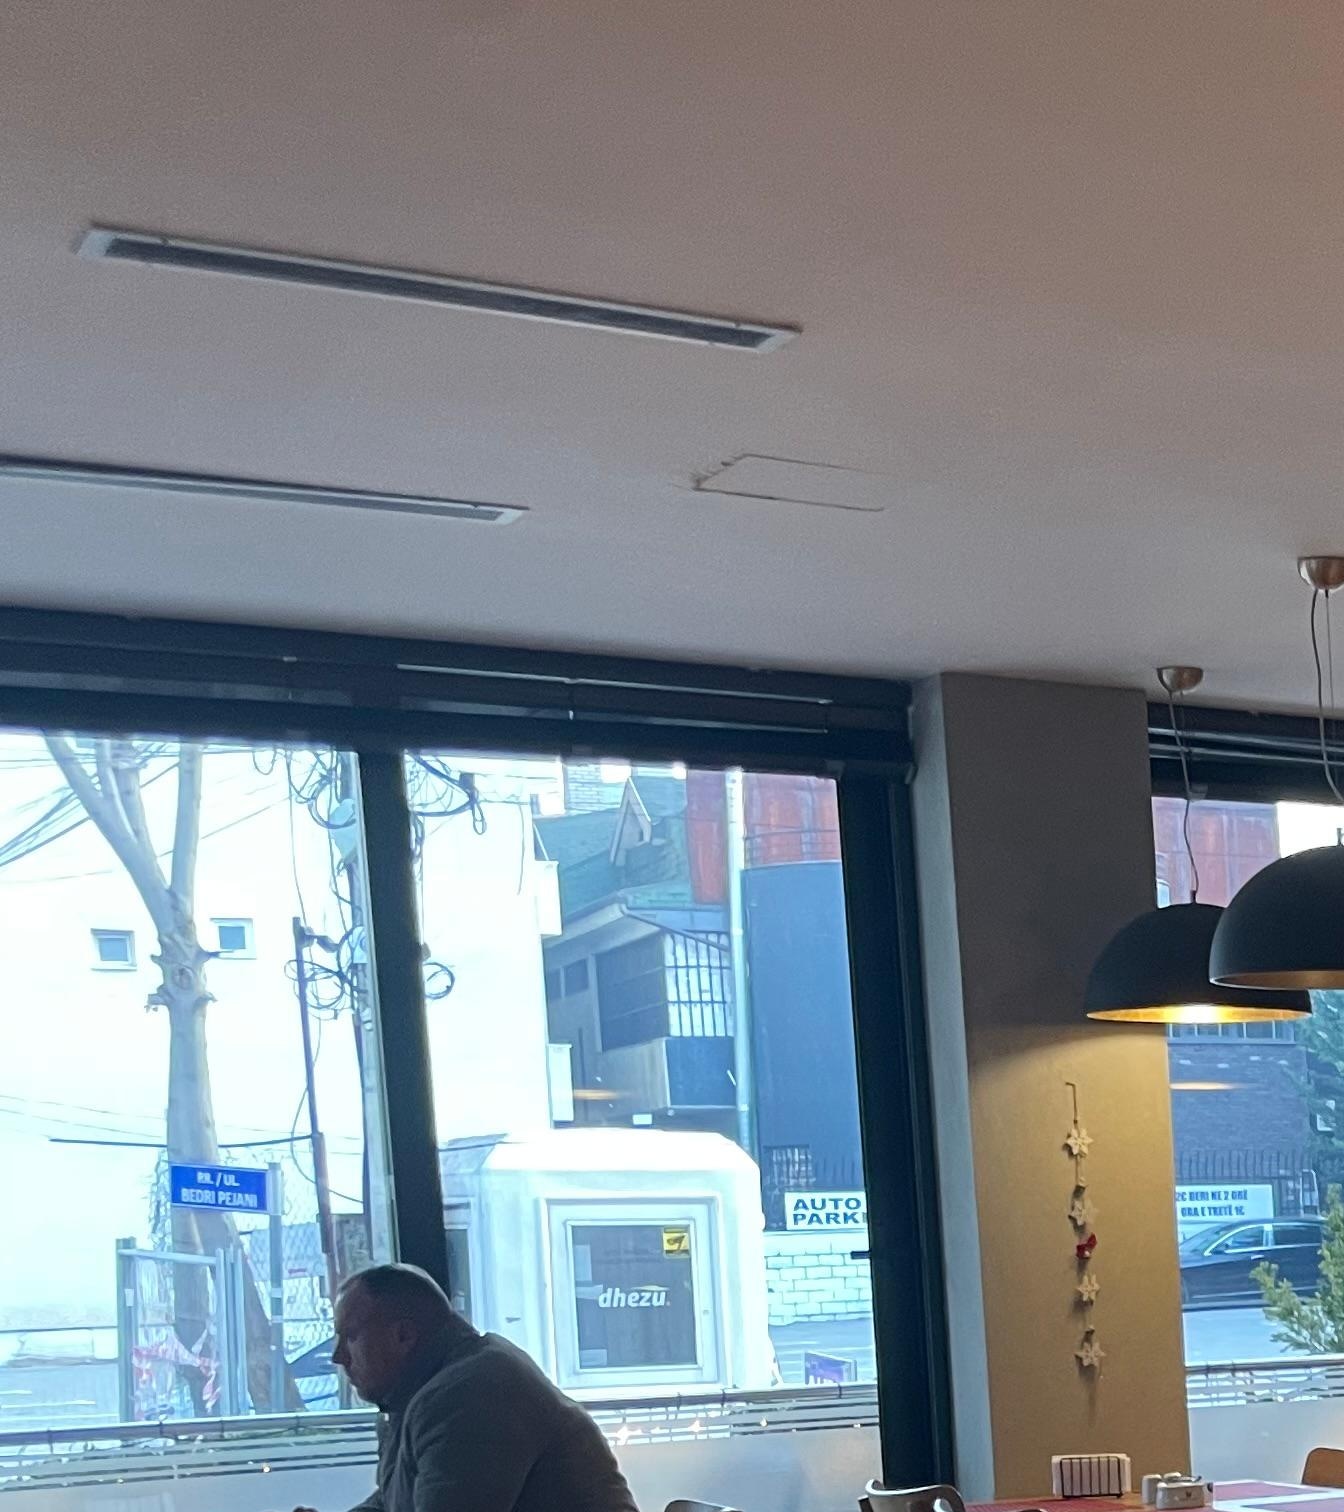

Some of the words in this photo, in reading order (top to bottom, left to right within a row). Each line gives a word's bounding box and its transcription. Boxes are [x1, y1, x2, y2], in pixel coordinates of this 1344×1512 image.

[181, 1187, 216, 1205] BEDRI
[217, 1191, 258, 1209] PEJANI
[793, 1197, 862, 1211] AUTO
